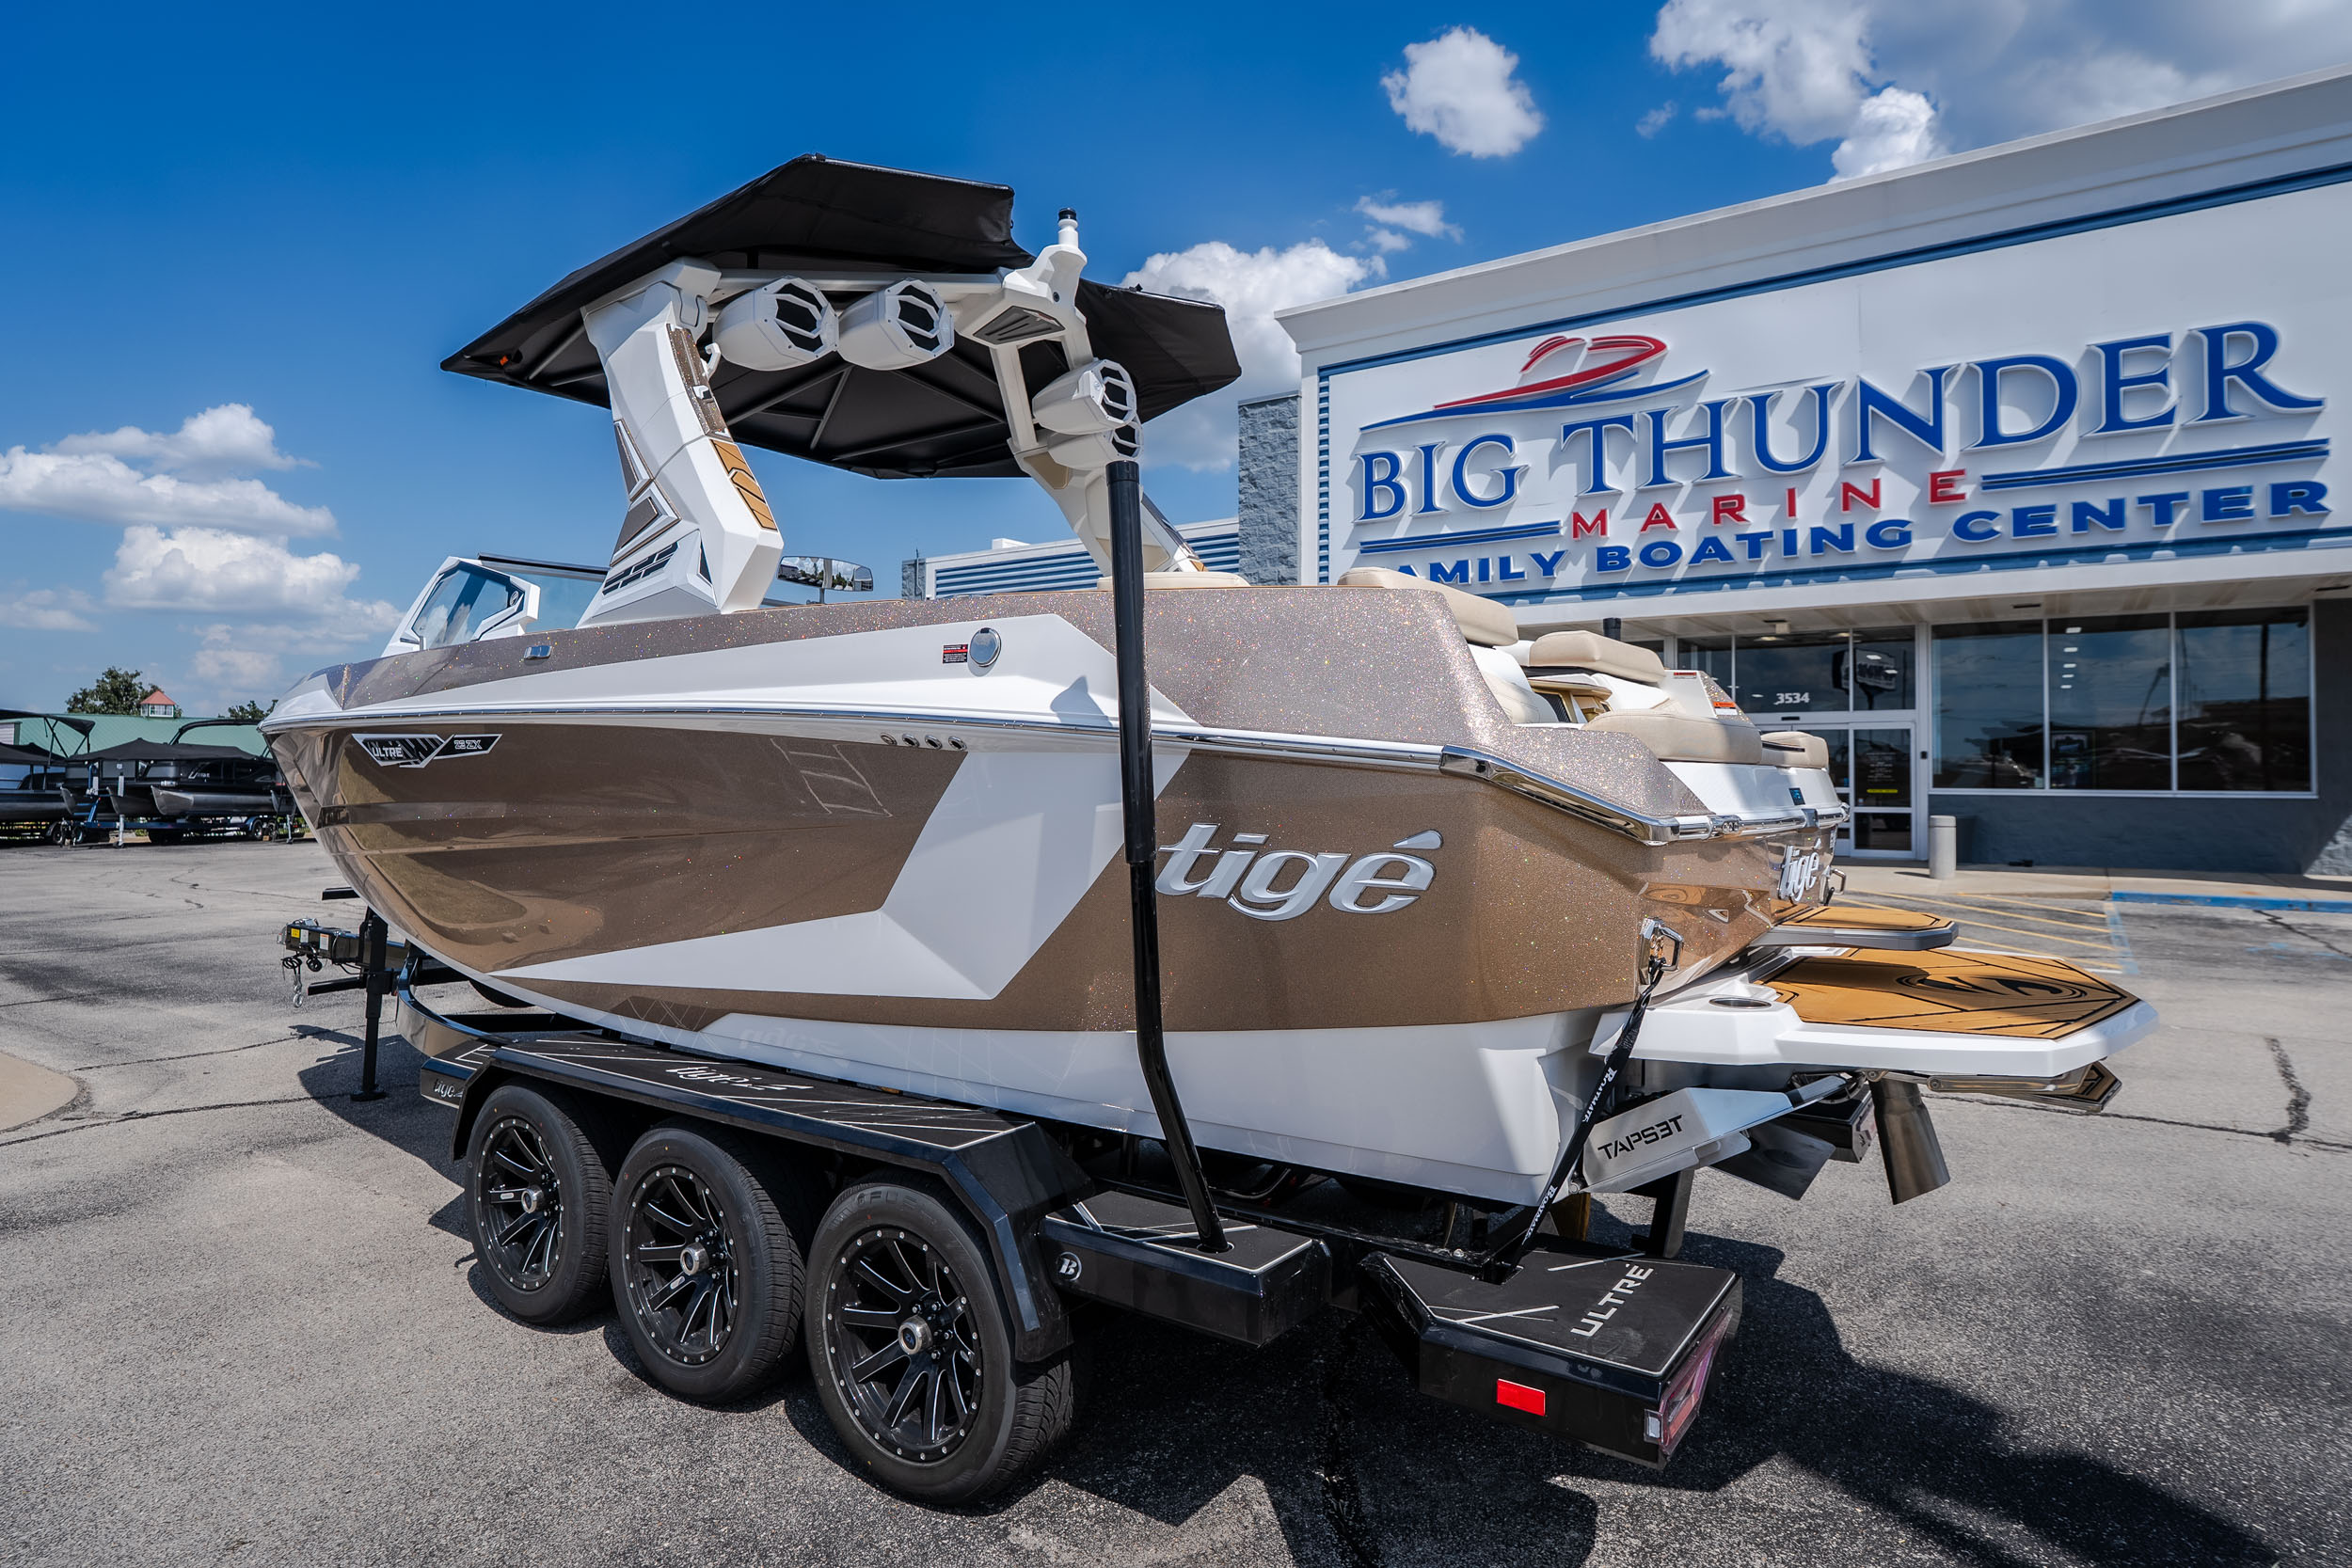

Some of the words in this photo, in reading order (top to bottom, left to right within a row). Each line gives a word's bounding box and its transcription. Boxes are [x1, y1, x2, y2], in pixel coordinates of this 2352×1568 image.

[1353, 433, 1530, 523] BIG
[1561, 321, 2327, 497] THUNDER
[1572, 469, 1966, 539] MARINE
[1596, 519, 1915, 573] BOATING
[1952, 480, 2331, 543] CENTER
[1775, 692, 1810, 705] 3534
[1154, 822, 1444, 921] tigé
[1779, 837, 1821, 903] tigé
